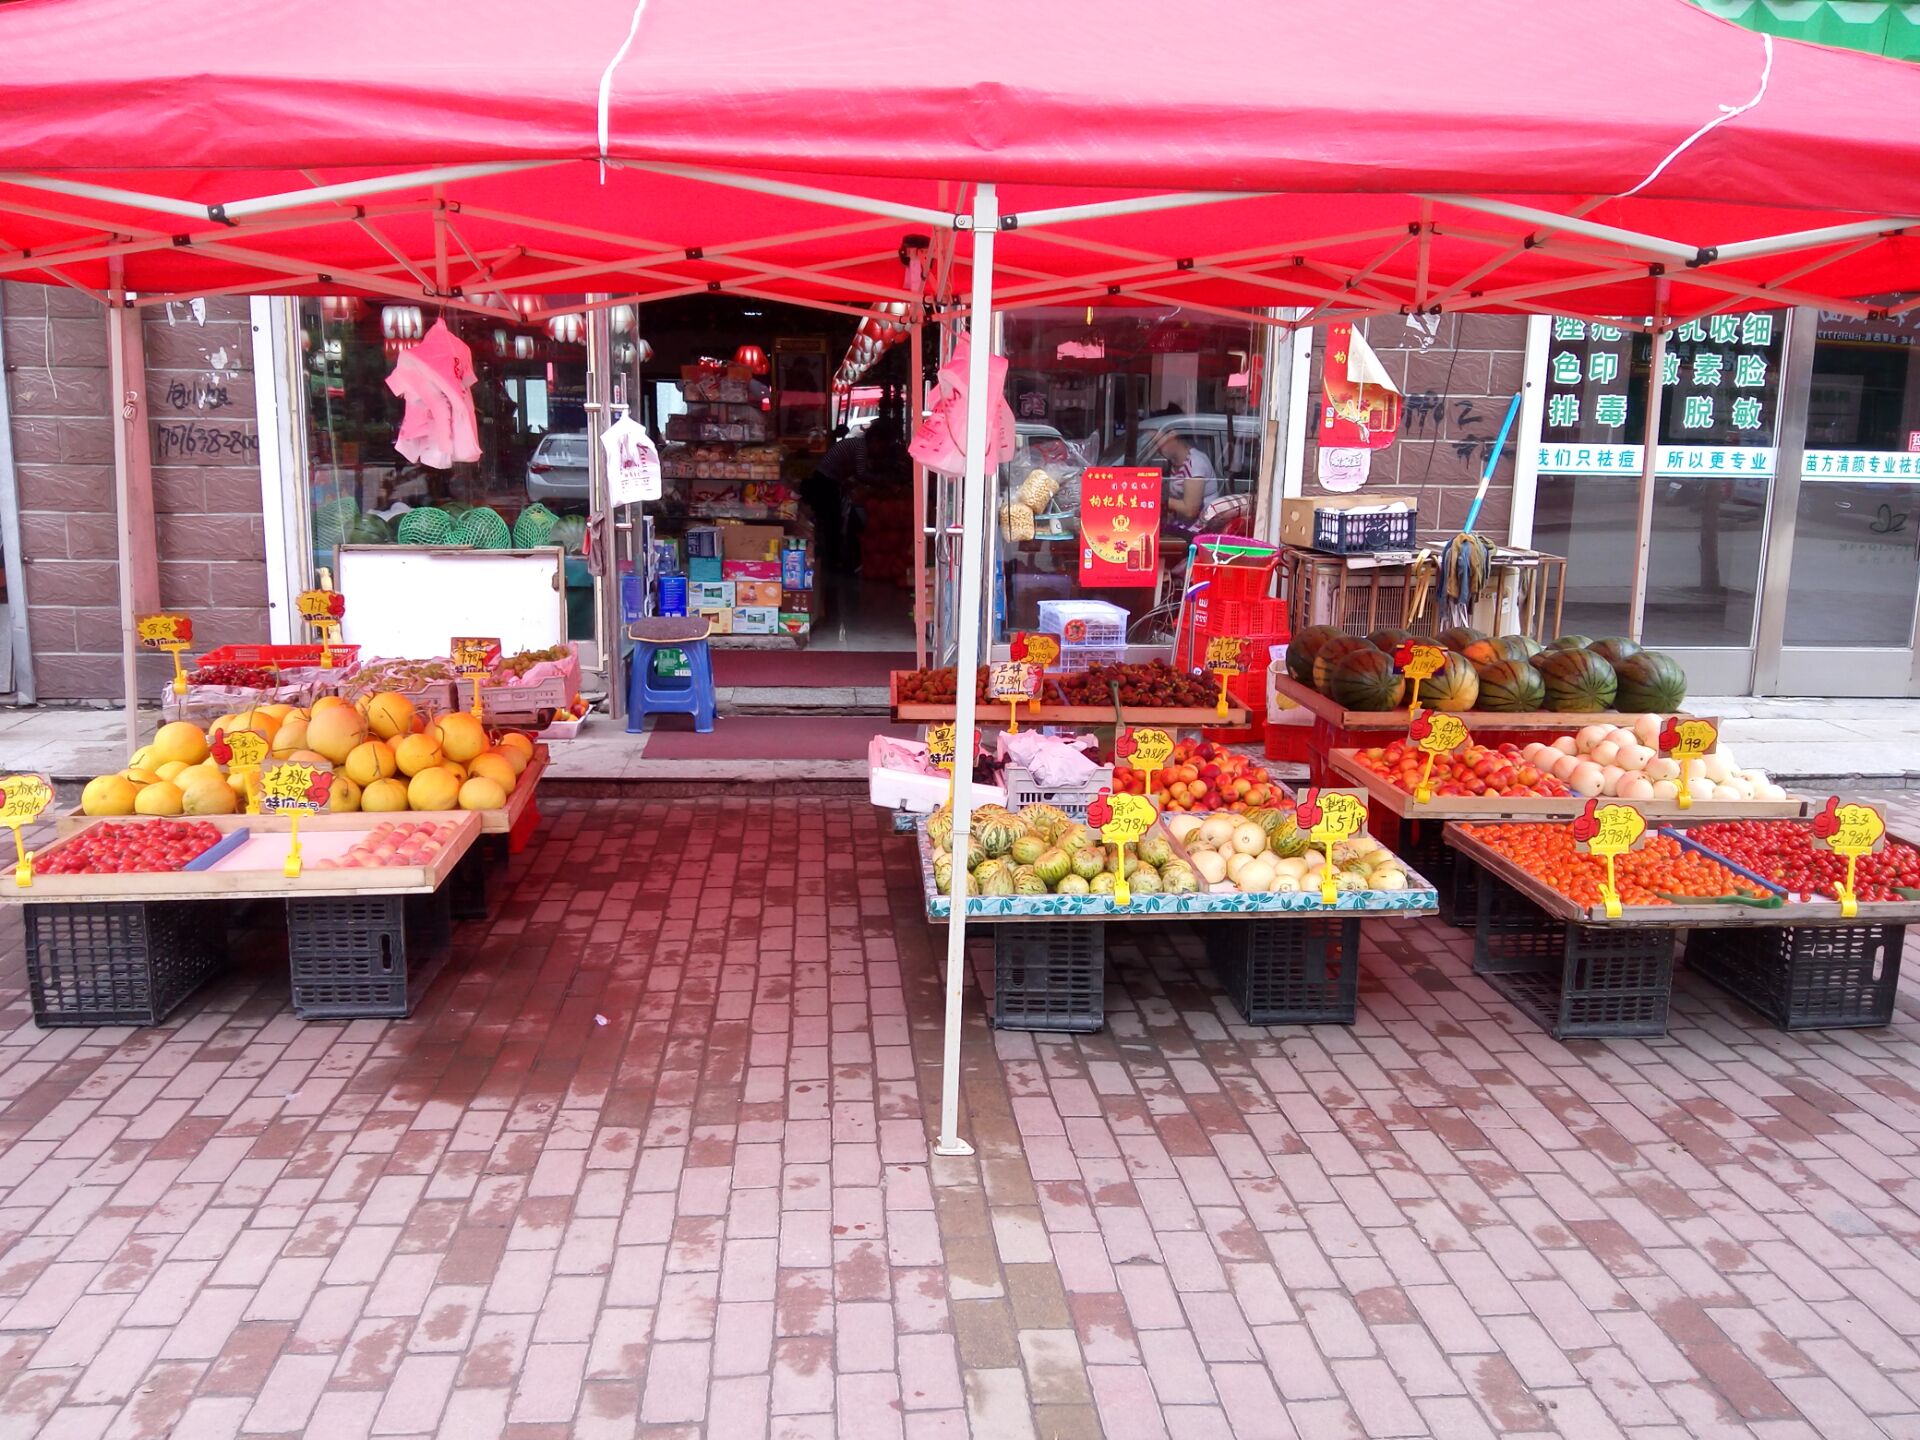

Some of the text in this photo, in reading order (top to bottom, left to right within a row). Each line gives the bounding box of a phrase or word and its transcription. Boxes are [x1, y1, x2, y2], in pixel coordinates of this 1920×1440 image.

[1552, 350, 1619, 384] 色印
[1548, 394, 1764, 430] 排毒 脱敏
[1537, 448, 1636, 468] 我们只祛痘
[1667, 450, 1767, 470] 所以更专业
[934, 727, 956, 746] 黑
